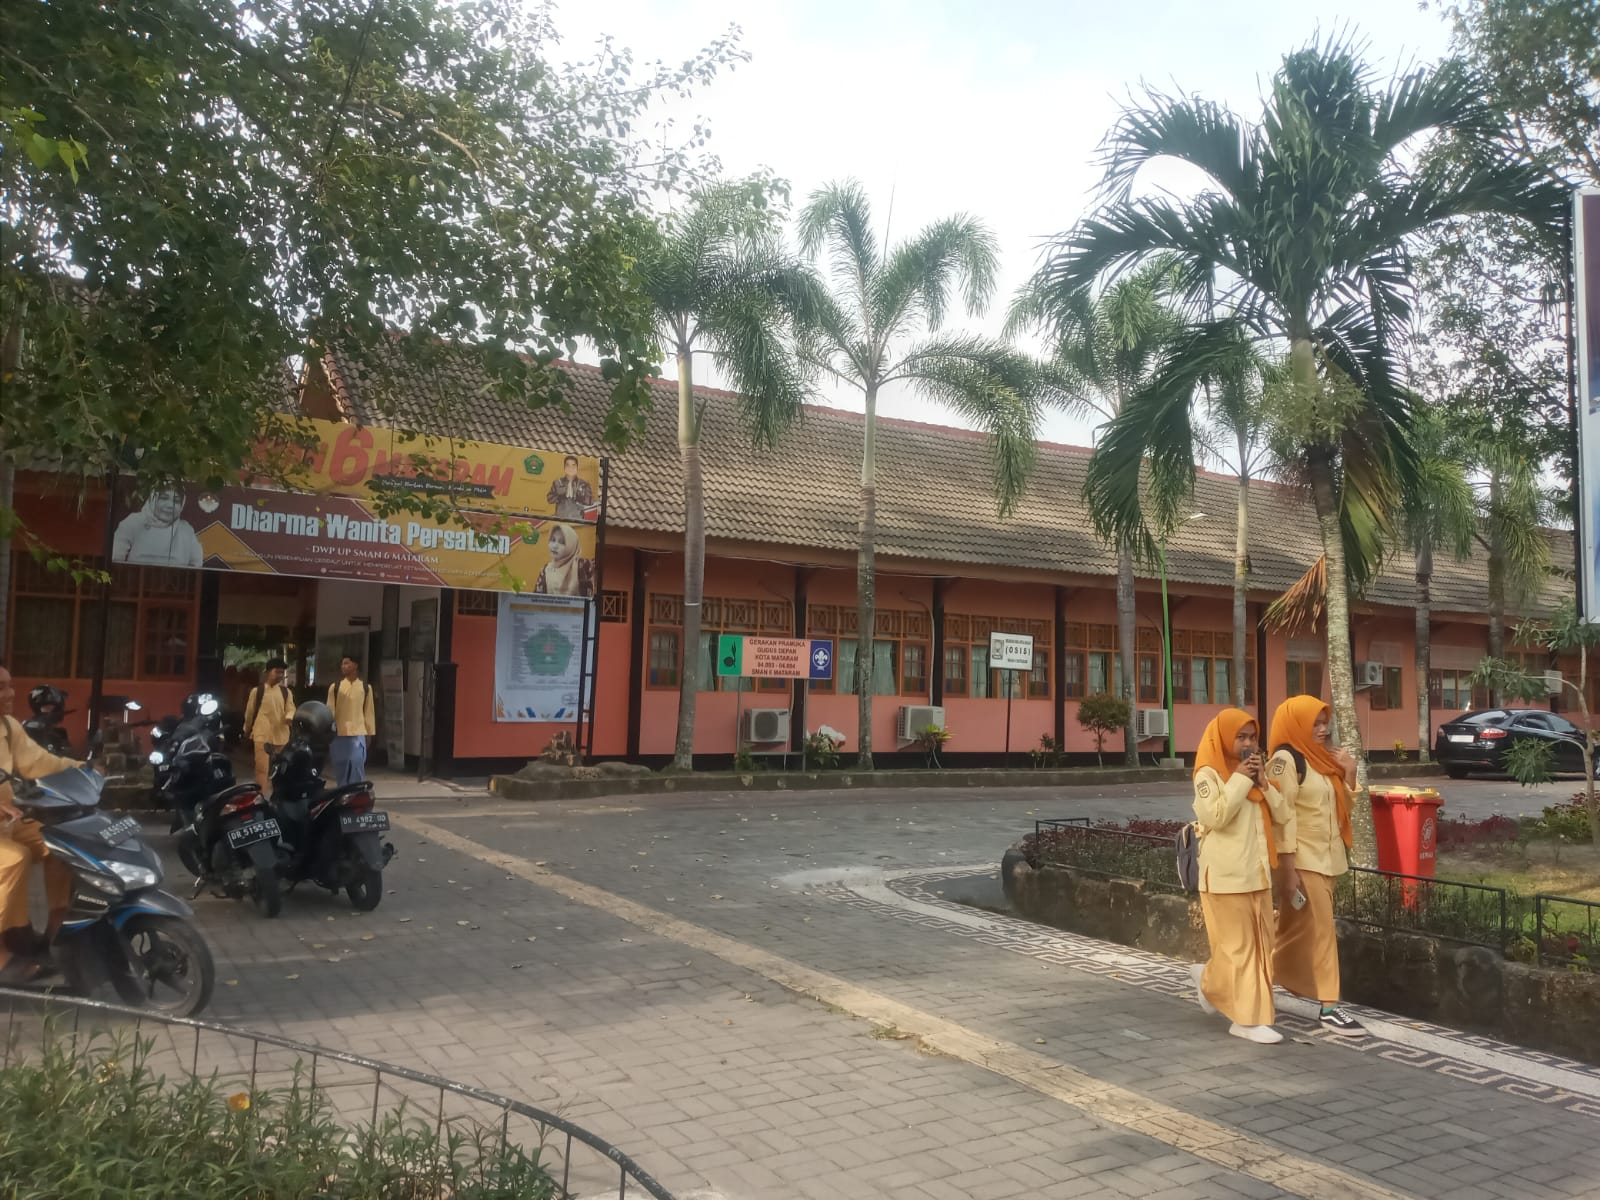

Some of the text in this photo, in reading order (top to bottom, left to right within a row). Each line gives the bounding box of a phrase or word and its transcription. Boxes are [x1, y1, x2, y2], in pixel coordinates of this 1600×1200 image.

[329, 426, 374, 486] 6
[231, 503, 319, 537] Dharma
[326, 513, 401, 544] Wanita
[312, 545, 439, 563] DWP UP SMAN 6 MATARAM
[230, 830, 242, 840] DR
